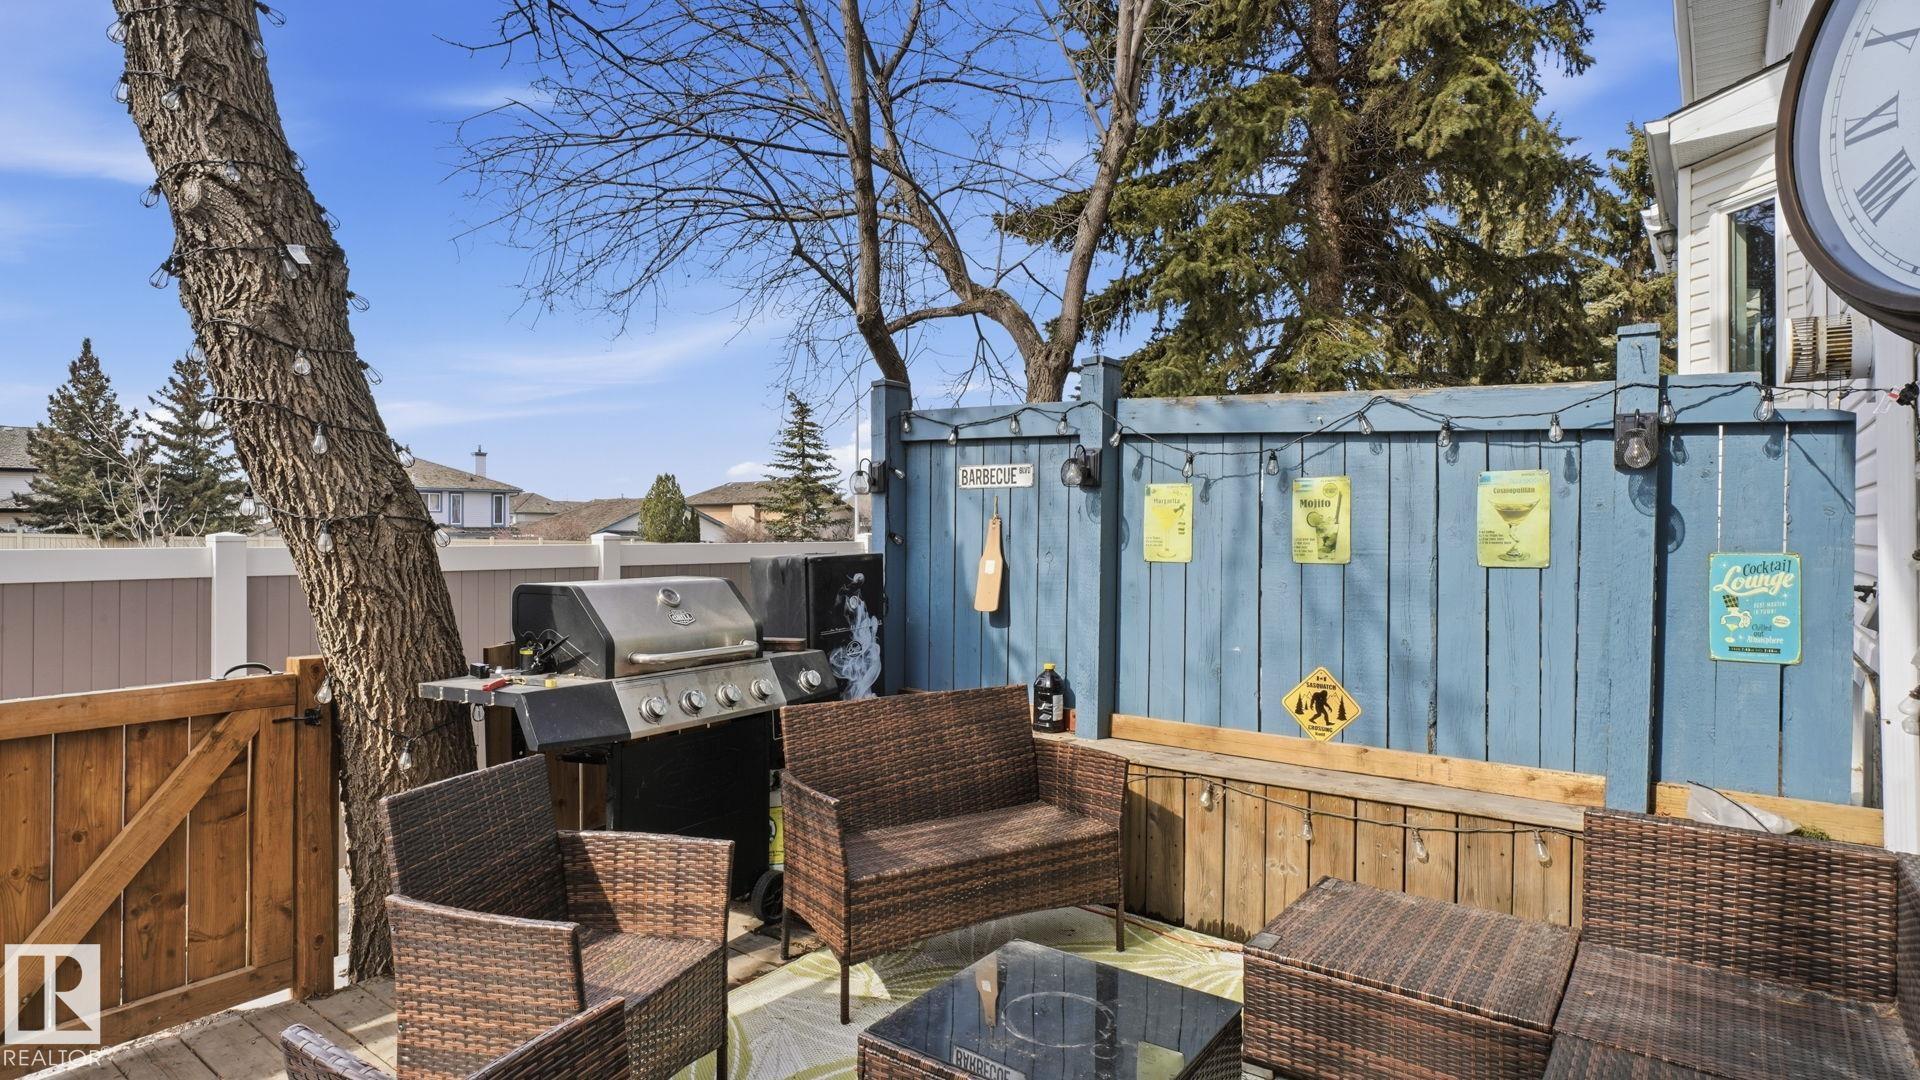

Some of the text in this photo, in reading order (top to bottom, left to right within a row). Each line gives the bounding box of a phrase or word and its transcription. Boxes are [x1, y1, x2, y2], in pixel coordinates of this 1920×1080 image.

[961, 467, 1017, 486] BARBECUE
[1299, 499, 1331, 508] Mojito
[1743, 559, 1792, 576] Cocktail
[1713, 566, 1795, 596] Lounge
[1306, 682, 1337, 690] SASQUATCH
[1307, 724, 1333, 733] CROSSING
